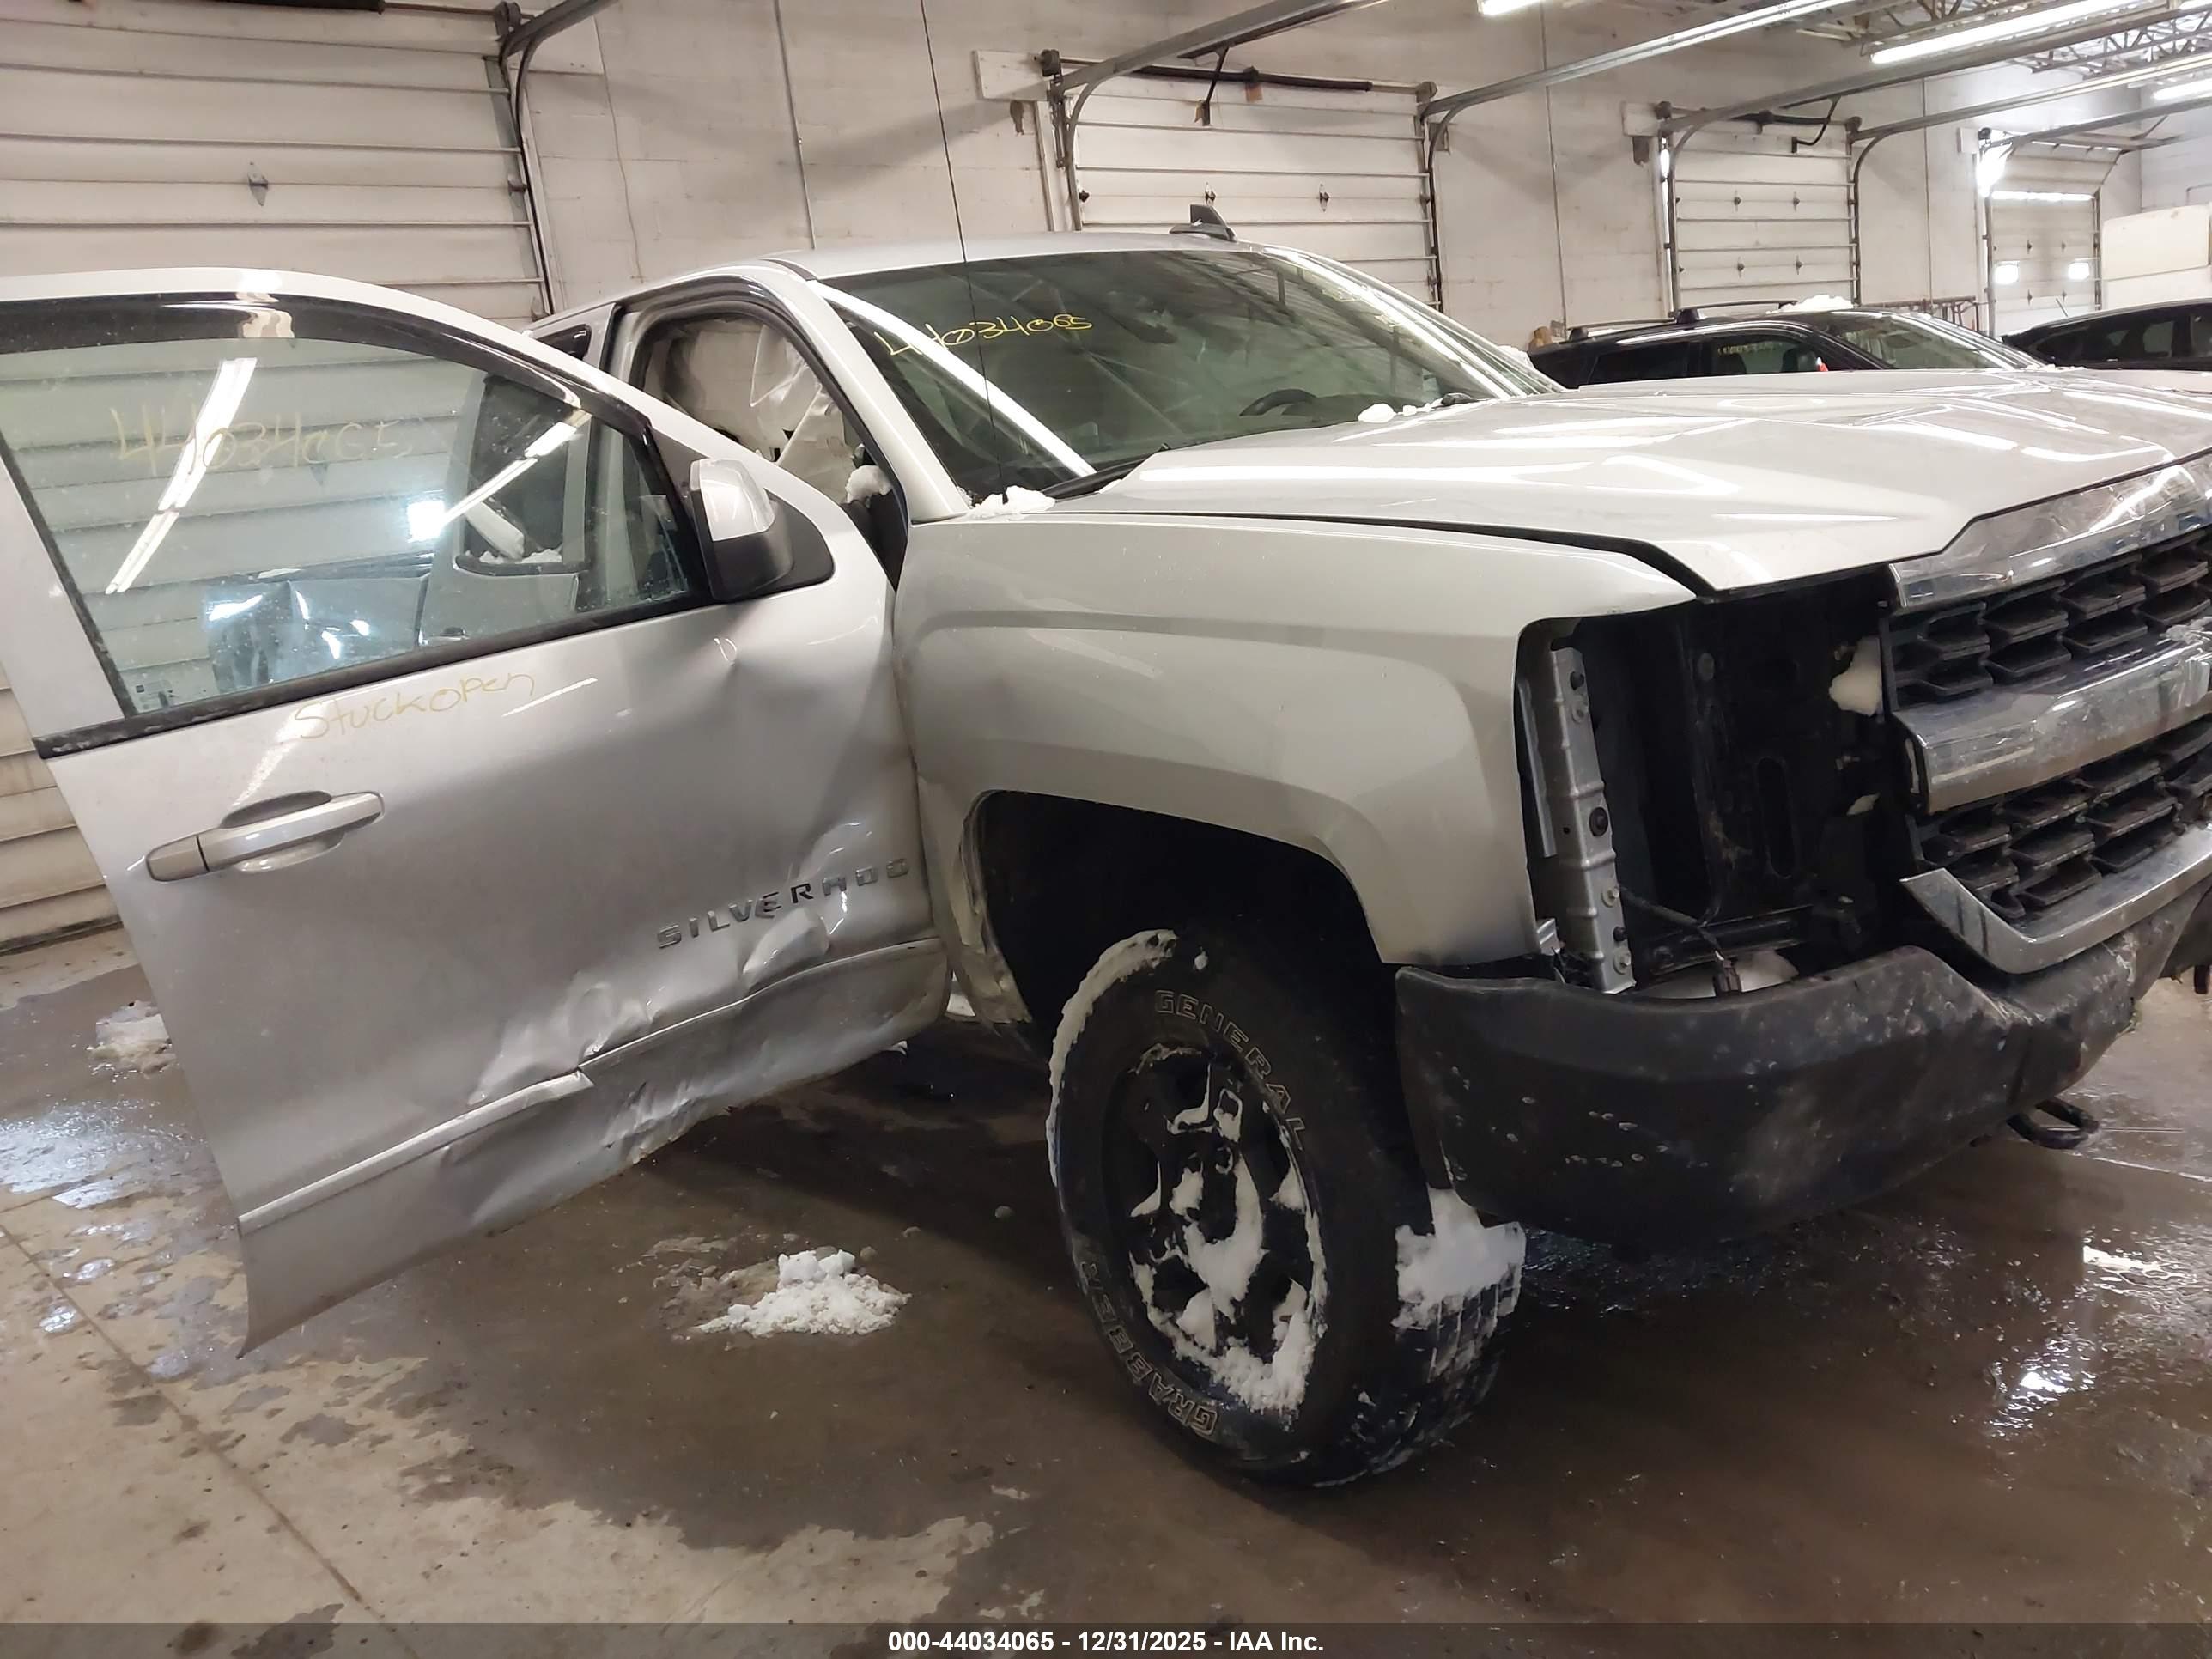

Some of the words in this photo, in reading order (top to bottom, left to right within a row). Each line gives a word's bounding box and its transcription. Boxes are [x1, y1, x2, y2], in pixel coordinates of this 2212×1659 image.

[874, 313, 1093, 357] 44034065
[656, 858, 910, 949] SILVERADO
[1153, 988, 1309, 1152] GENERAL
